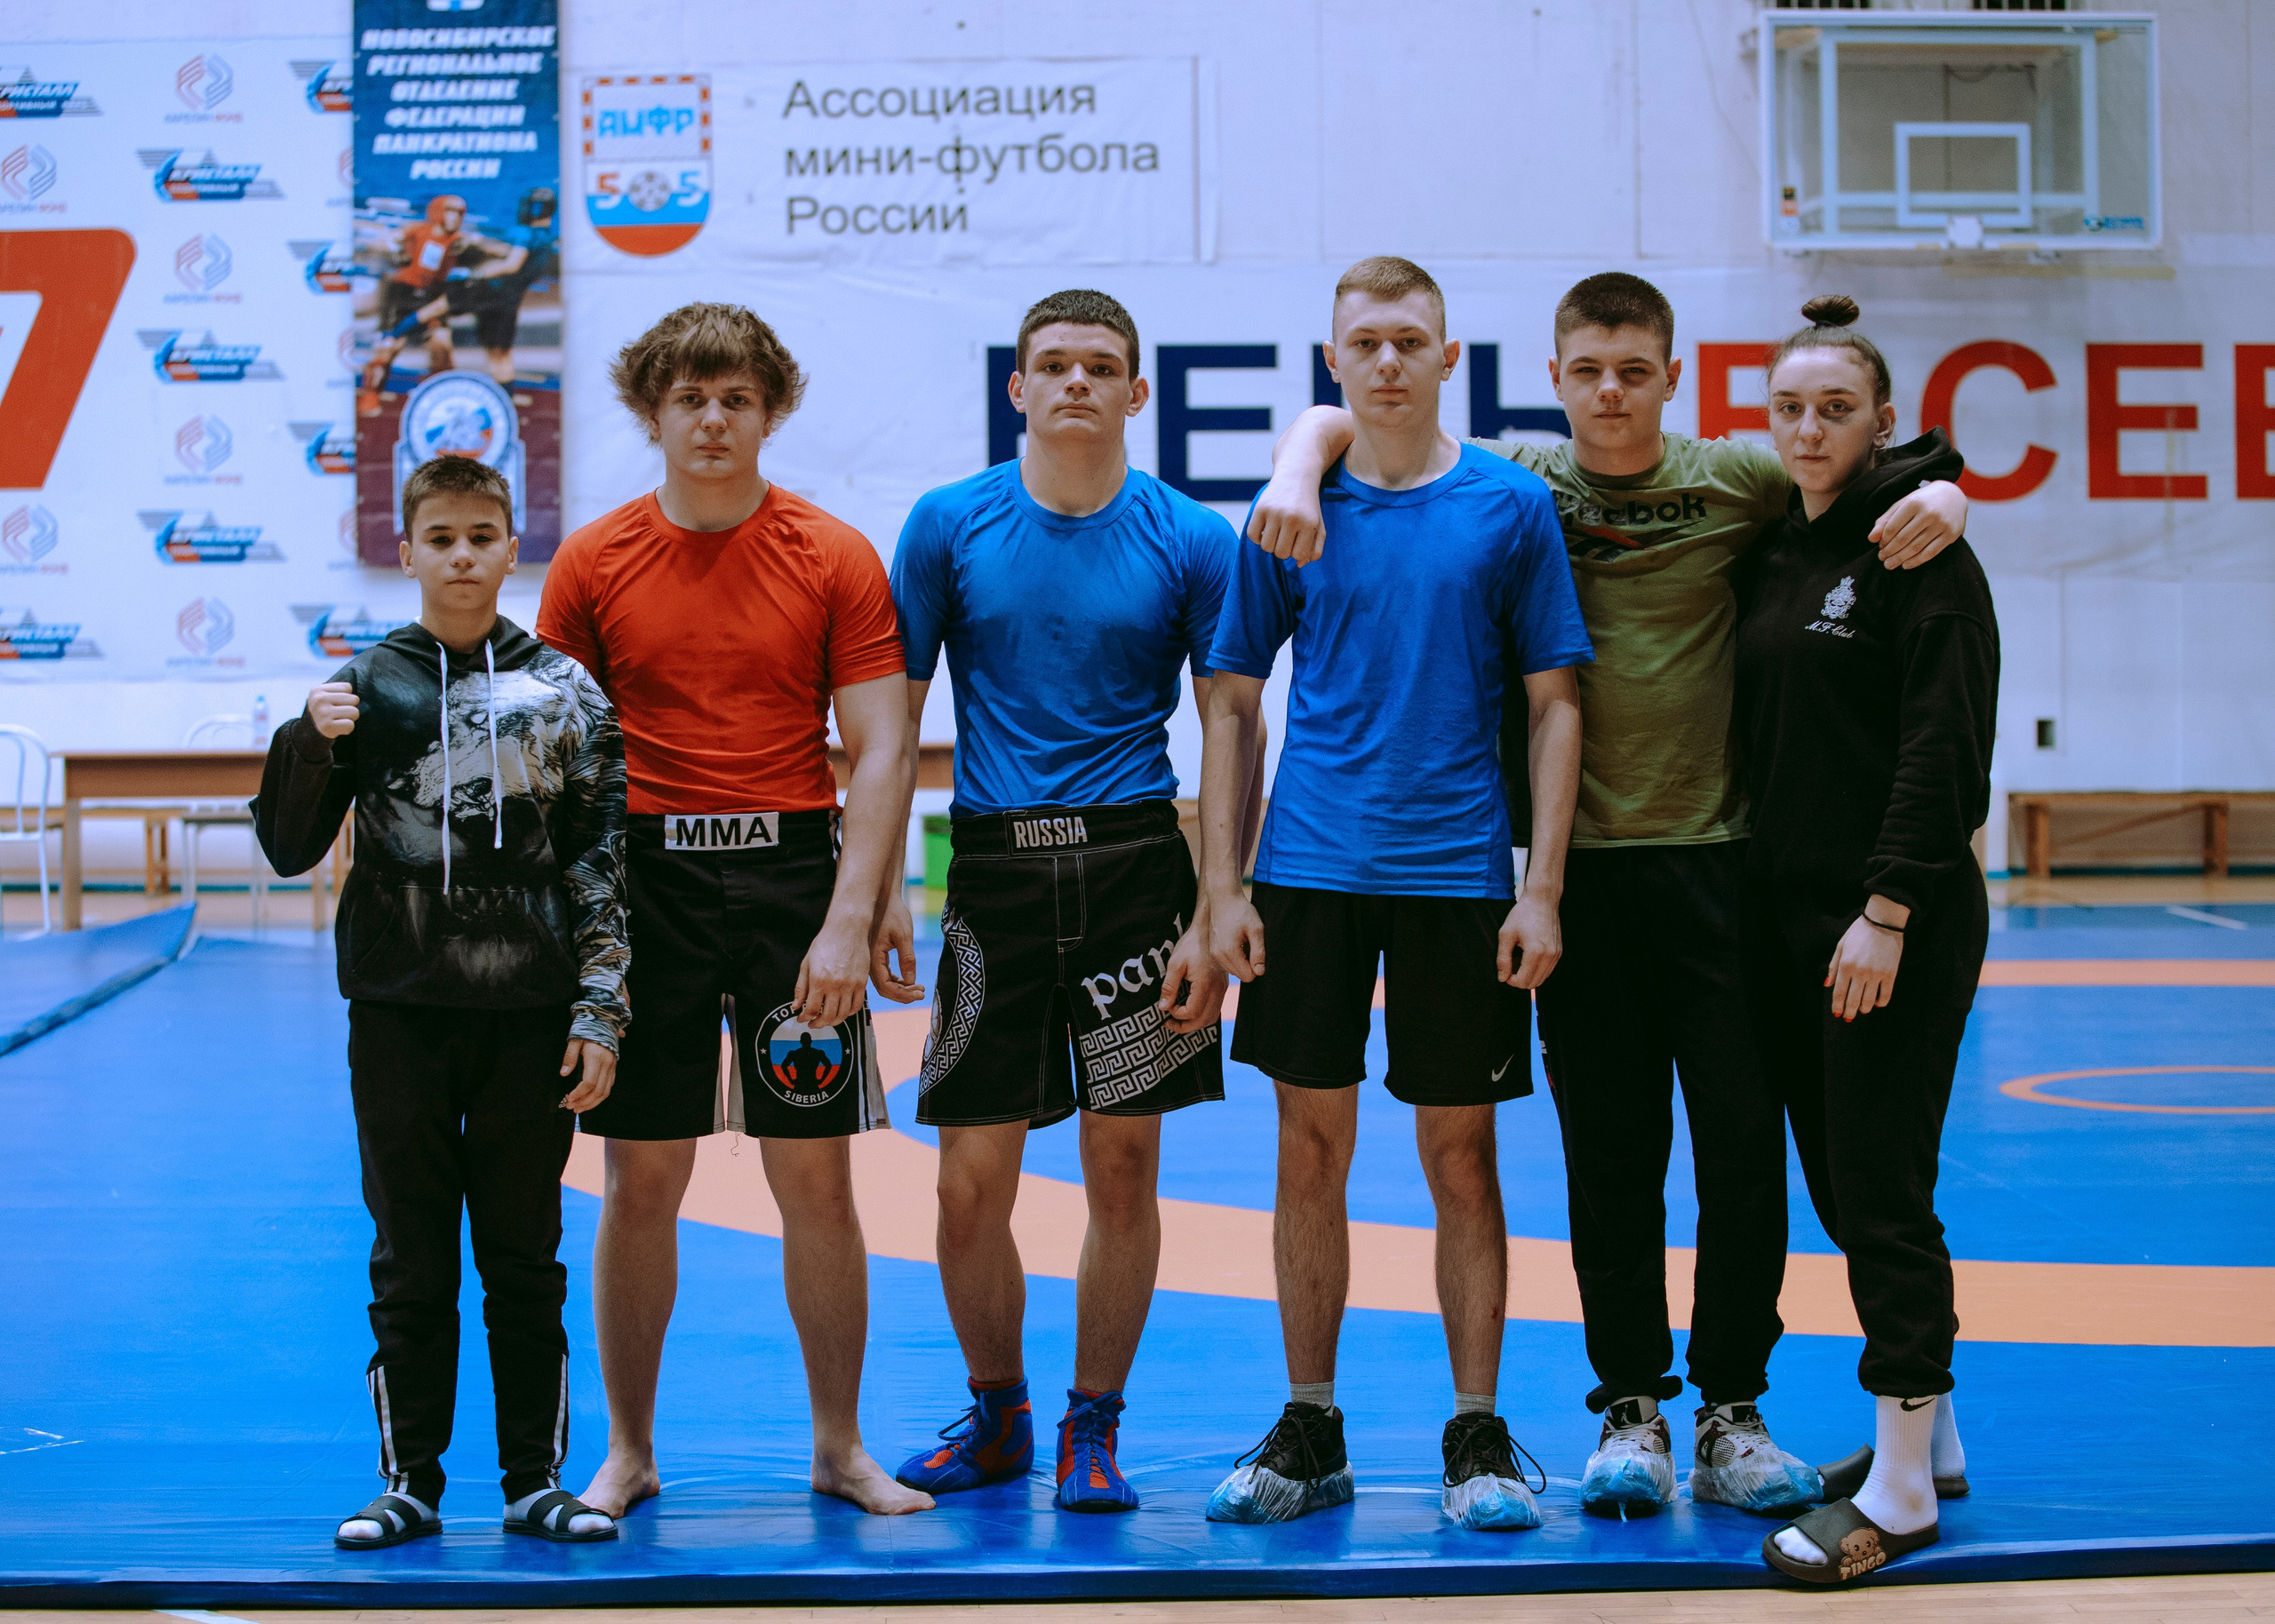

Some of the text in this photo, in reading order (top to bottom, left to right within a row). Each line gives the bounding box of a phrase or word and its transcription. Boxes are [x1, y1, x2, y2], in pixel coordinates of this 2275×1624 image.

[366, 52, 544, 76] РЕГИОНАЛЬНОЕ
[390, 79, 519, 101] ОТДЕЛЕНИЕ
[782, 80, 1097, 123] Ассоциация
[384, 106, 527, 129] ФЕДЕРАЦИИ
[372, 131, 538, 155] ПАНКРАТИОНА
[410, 158, 502, 180] РОССИИ
[785, 133, 1160, 184] мини-футбола
[786, 196, 968, 235] России
[675, 816, 773, 848] MMA
[1013, 816, 1089, 848] RUSSIA
[784, 1089, 830, 1104] SIBERIA
